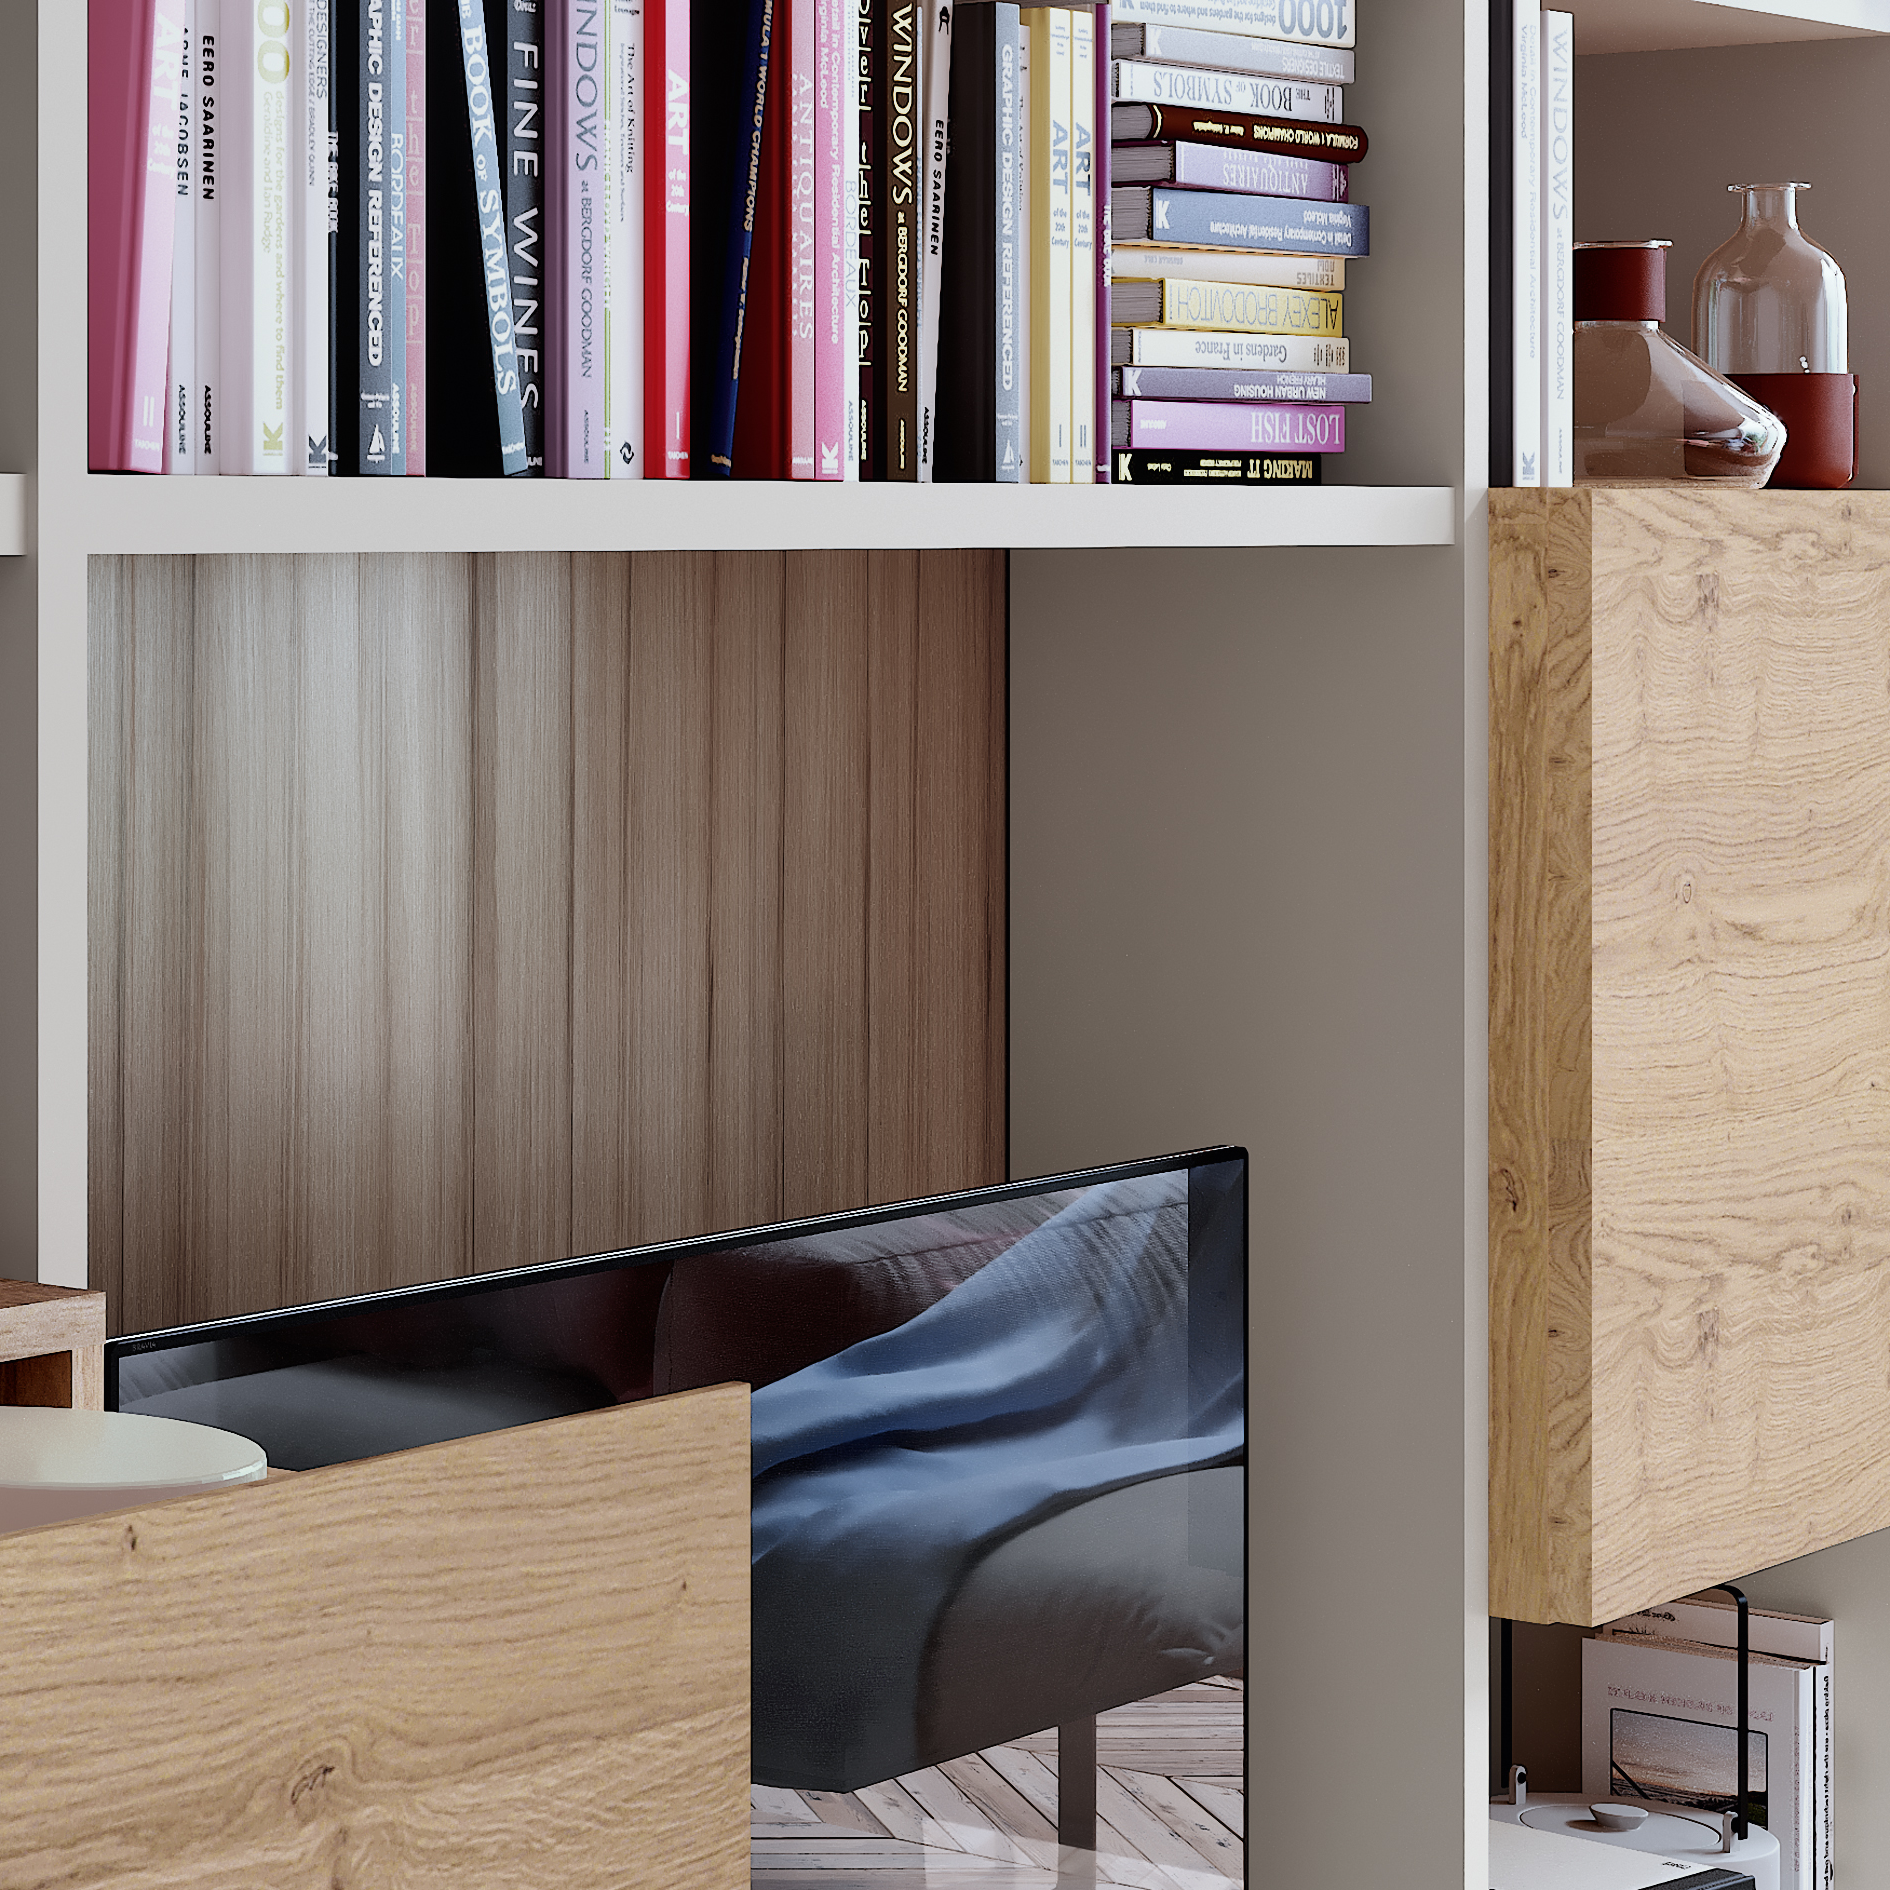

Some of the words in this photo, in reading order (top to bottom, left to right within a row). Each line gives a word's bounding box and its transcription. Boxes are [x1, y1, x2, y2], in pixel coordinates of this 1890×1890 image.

[1278, 0, 1349, 39] 1000
[203, 35, 215, 87] EERO
[626, 43, 635, 70] The
[627, 73, 635, 95] Art
[820, 47, 829, 109] McLeod
[463, 25, 492, 147] BOOK
[514, 41, 538, 177] FINE
[627, 100, 635, 114] of
[668, 69, 689, 155] ART
[830, 51, 840, 160] Contemporary
[892, 3, 912, 205] WINDOWS
[1001, 44, 1013, 146] GRAPHIC
[1153, 71, 1232, 105] SYMBOLS
[1235, 81, 1246, 92] OF
[1249, 83, 1293, 111] BOOK
[1296, 88, 1311, 101] THE
[203, 96, 215, 201] SAARINEN
[368, 82, 383, 182] DESIGN
[934, 119, 944, 162] EERO
[1552, 27, 1569, 221] WINDOWS
[477, 154, 488, 182] OF
[1052, 120, 1069, 194] ART
[1075, 121, 1092, 199] ART
[1223, 163, 1308, 195] ANTIQUAIRES
[797, 74, 813, 338] ANTIQUAIRES
[831, 164, 840, 248] Residential
[930, 169, 942, 255] SAARINEN
[1002, 151, 1013, 236] DESIGN
[845, 180, 856, 308] BORDEAUX
[897, 226, 907, 308] BERGDORF
[368, 190, 383, 366] REFERENCED
[479, 189, 517, 395] SYMBOLS
[831, 252, 840, 344] Architecture
[1177, 284, 1278, 327] BRODOVITCH
[1296, 272, 1335, 286] TEXTILES
[1556, 240, 1565, 318] BERGDORF
[1001, 242, 1013, 391] REFERENCED
[1282, 294, 1339, 330] ALEXEY
[897, 309, 907, 393] GOODMAN
[1195, 340, 1231, 361] France
[1232, 349, 1244, 361] in
[1245, 342, 1287, 364] Gardens
[1556, 321, 1565, 400] GOODMAN
[1234, 384, 1274, 397] HOUSING
[1275, 385, 1305, 398] URBAN
[1306, 386, 1326, 399] NEW
[1250, 411, 1291, 444] FISH
[1294, 413, 1340, 446] LOST
[1247, 459, 1260, 478] IT
[1263, 458, 1313, 479] MAKING
